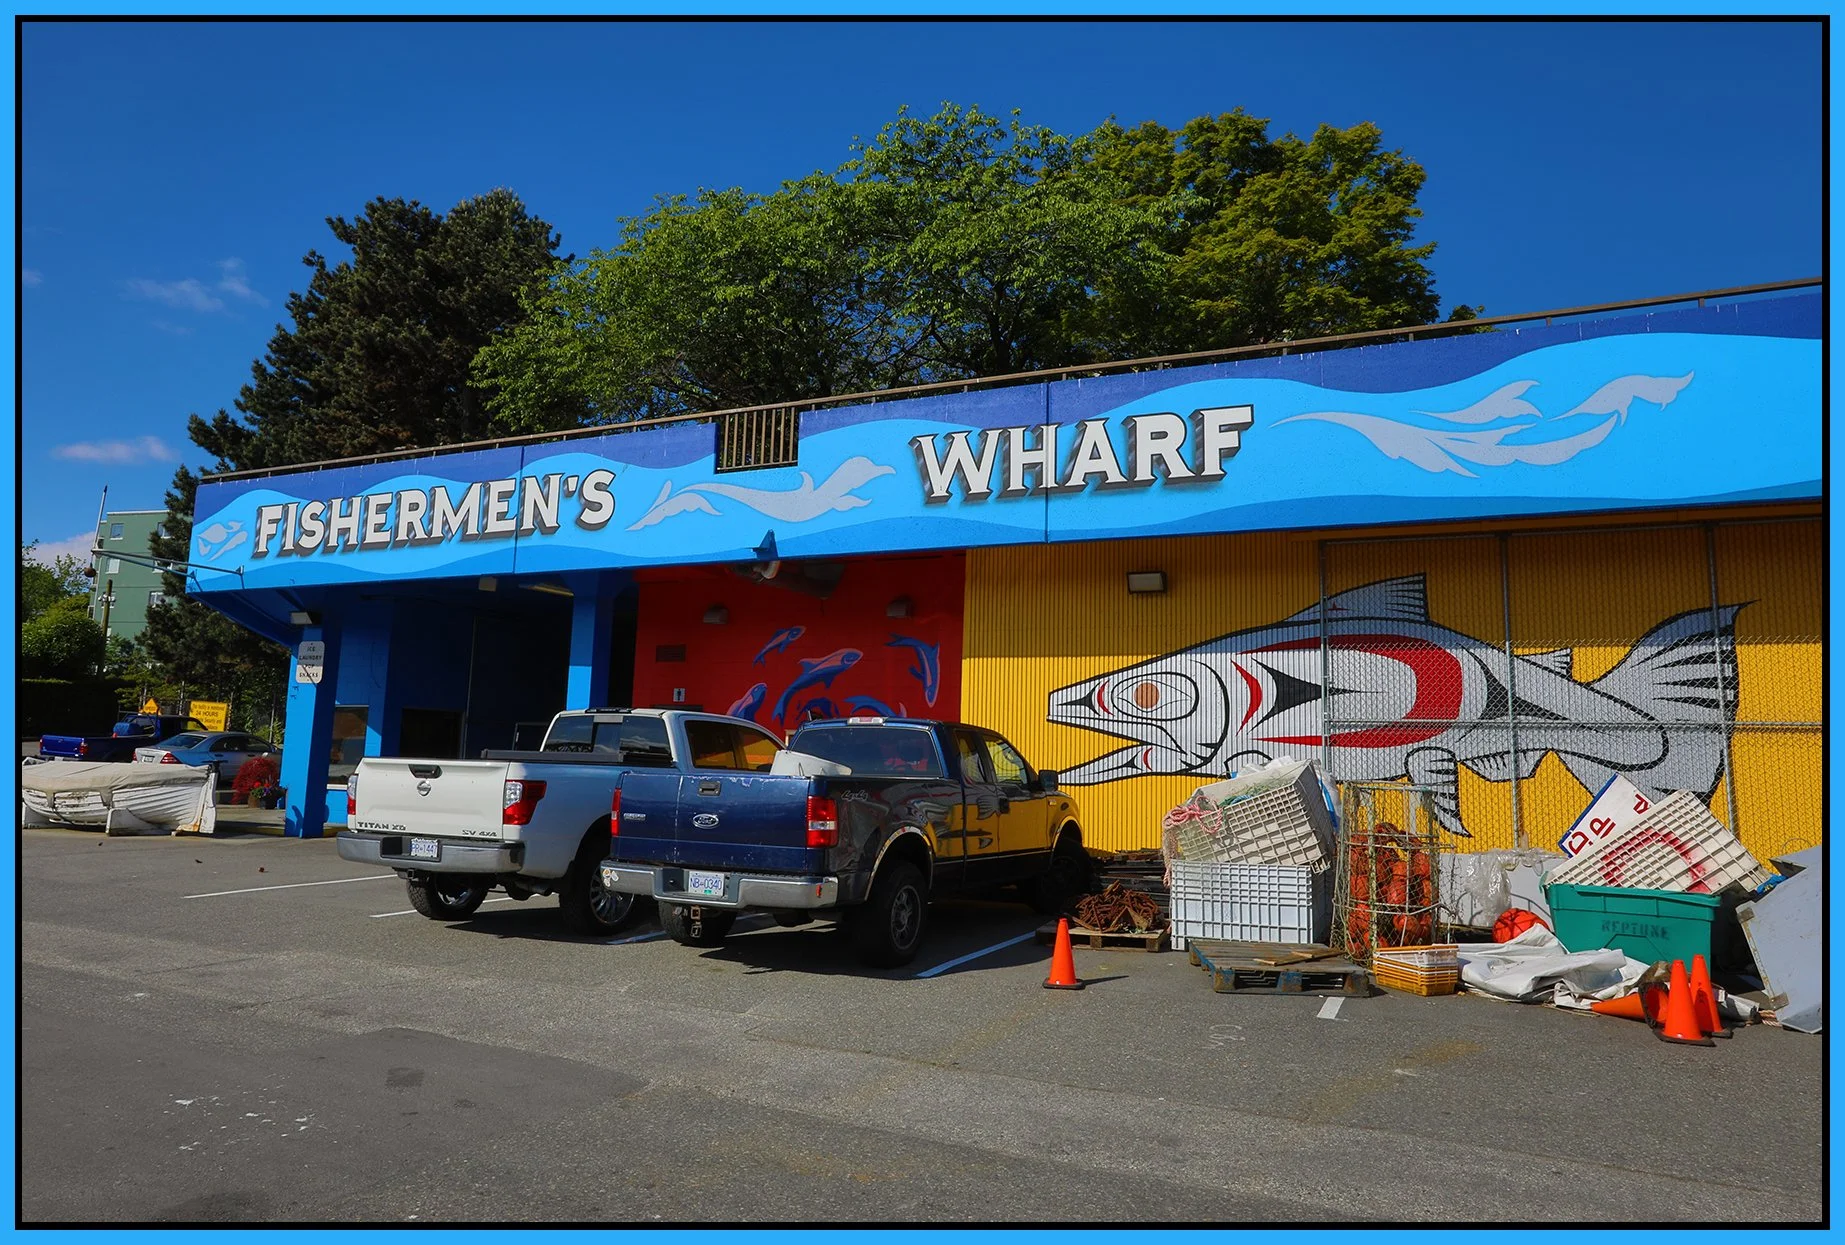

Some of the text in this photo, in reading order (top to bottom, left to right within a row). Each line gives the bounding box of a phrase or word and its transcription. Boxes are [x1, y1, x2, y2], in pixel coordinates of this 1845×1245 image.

[251, 404, 1254, 557] FISHERMEN'S WHARF
[357, 821, 389, 830] TITAN
[1601, 919, 1670, 940] NEPTUNE
